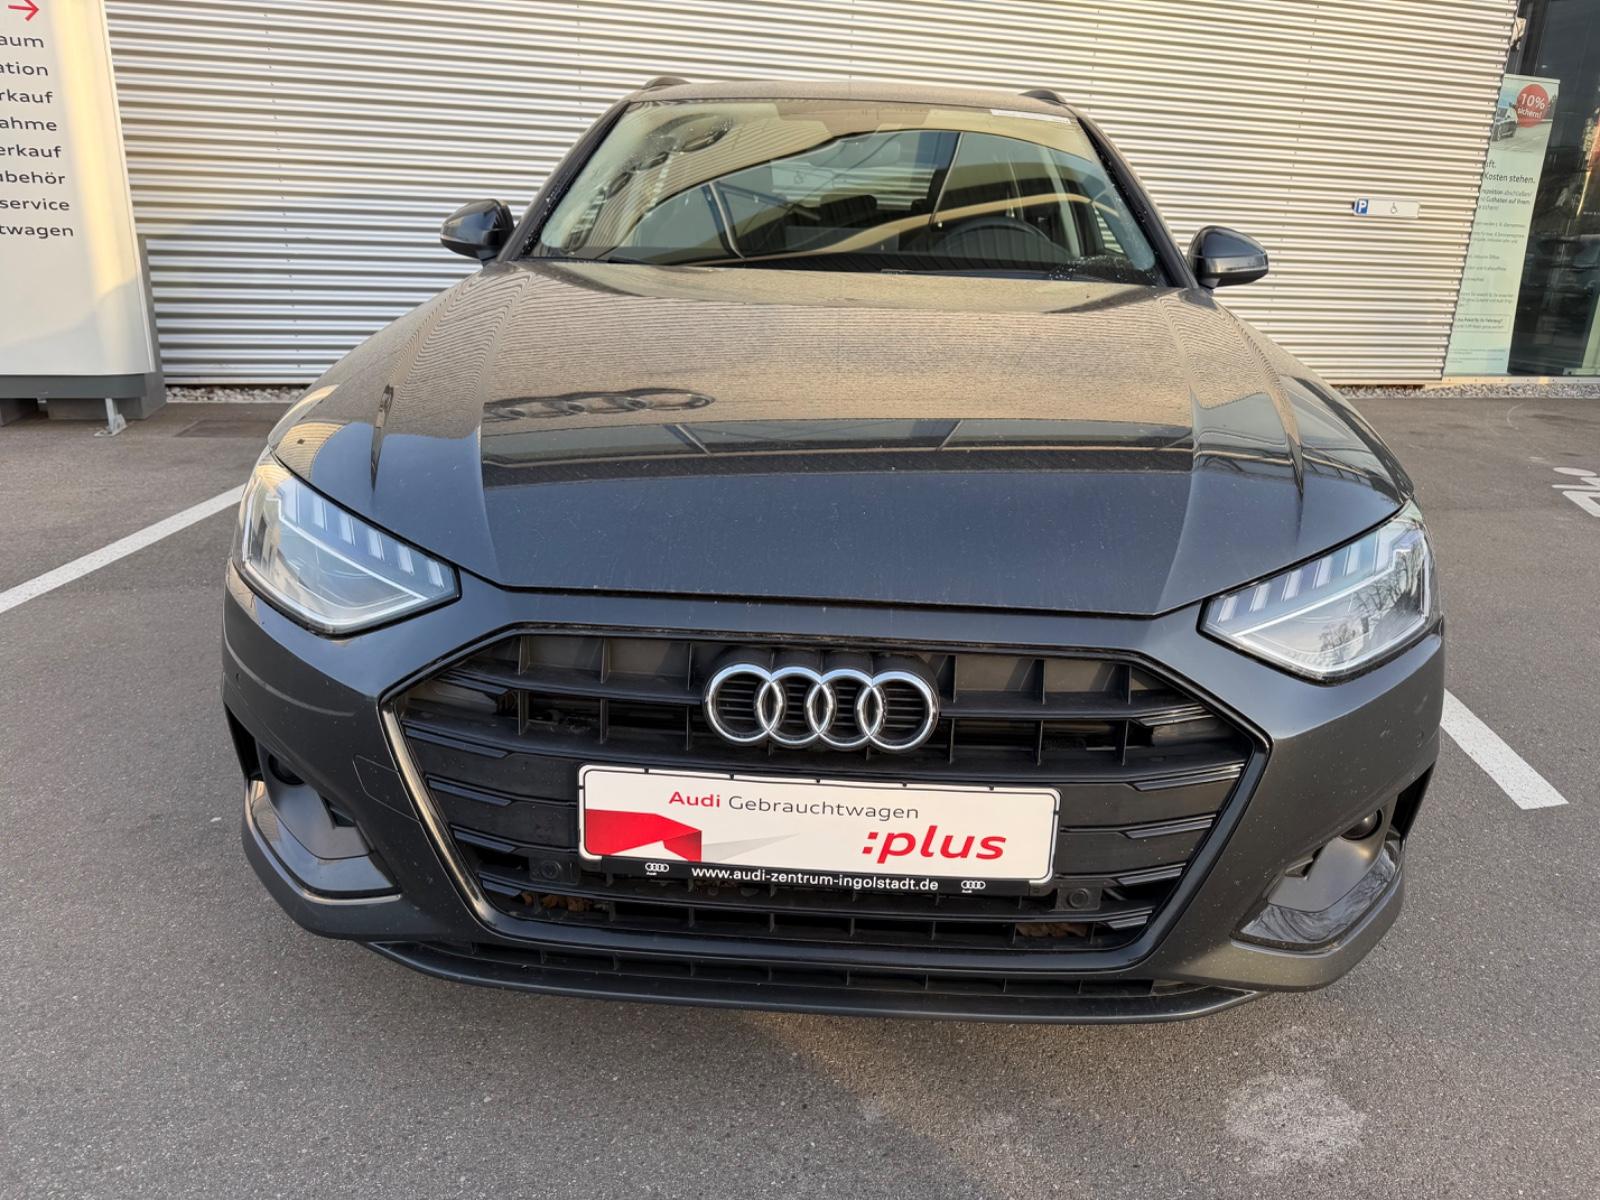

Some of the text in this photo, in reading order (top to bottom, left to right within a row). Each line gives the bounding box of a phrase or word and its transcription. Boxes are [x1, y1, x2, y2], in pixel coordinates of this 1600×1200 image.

[1519, 93, 1546, 110] 10%
[1517, 106, 1543, 119] sichern!
[1508, 174, 1536, 184] stehen.
[0, 197, 70, 211] service
[0, 224, 74, 239] twagen
[668, 791, 919, 822] Audi Gebrauchtwagen
[862, 825, 1007, 864] :plus
[691, 866, 939, 892] www.audi-zentrum-ingolstadt.de
